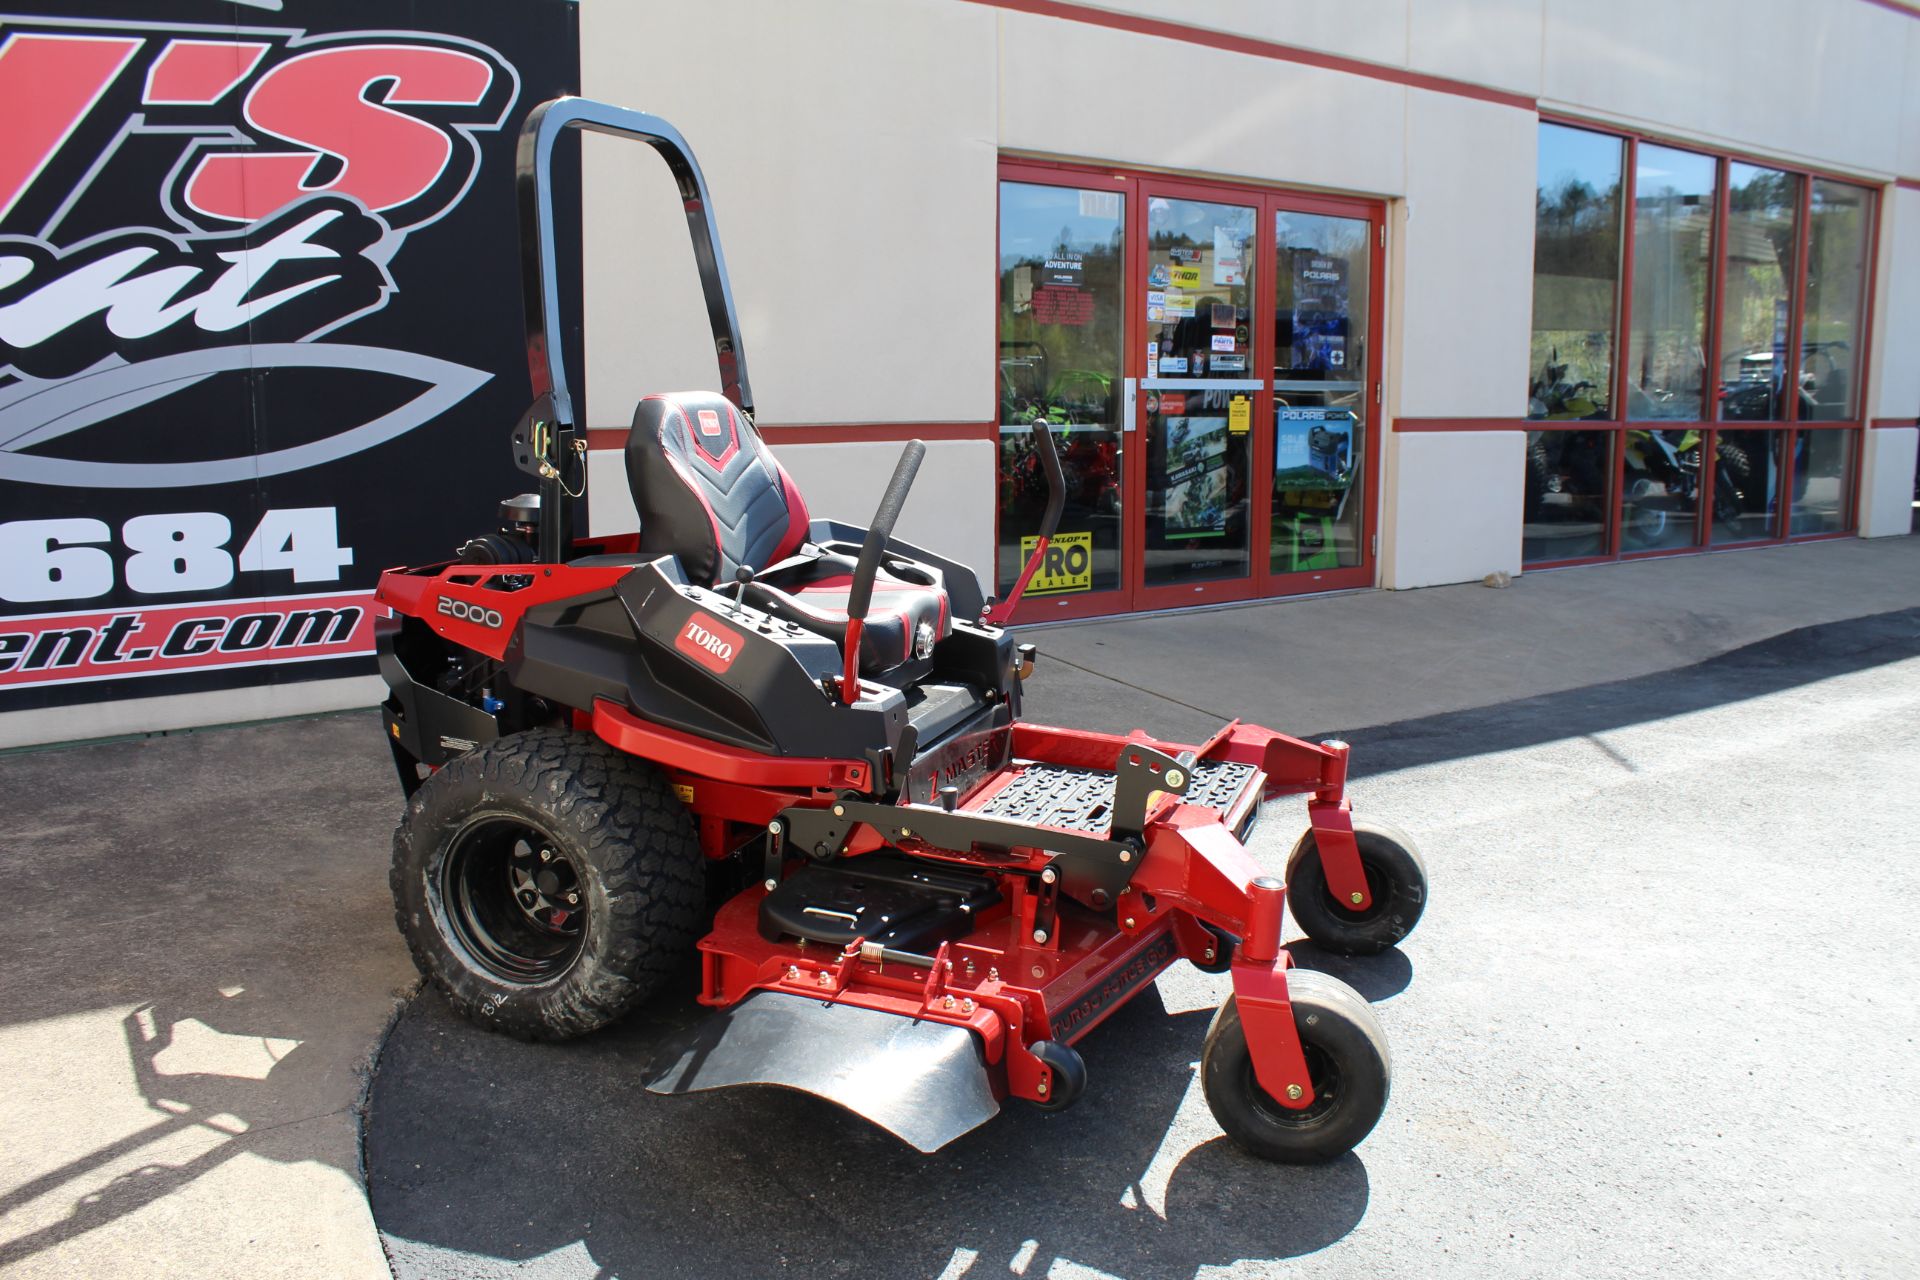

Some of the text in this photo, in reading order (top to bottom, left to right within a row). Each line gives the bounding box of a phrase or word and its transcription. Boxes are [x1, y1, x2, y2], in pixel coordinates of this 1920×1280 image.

[1045, 261, 1083, 270] ADVENTURE
[1173, 270, 1199, 281] THOR
[1303, 270, 1340, 281] POLARIS
[1150, 294, 1164, 302] VISA
[1282, 410, 1325, 421] POLARIS
[1048, 535, 1081, 545] UNLOP
[1036, 576, 1089, 588] EALER
[438, 595, 503, 629] 2000
[685, 622, 733, 660] TORO
[1053, 993, 1104, 1038] TURBO
[1103, 960, 1146, 999] FORCE
